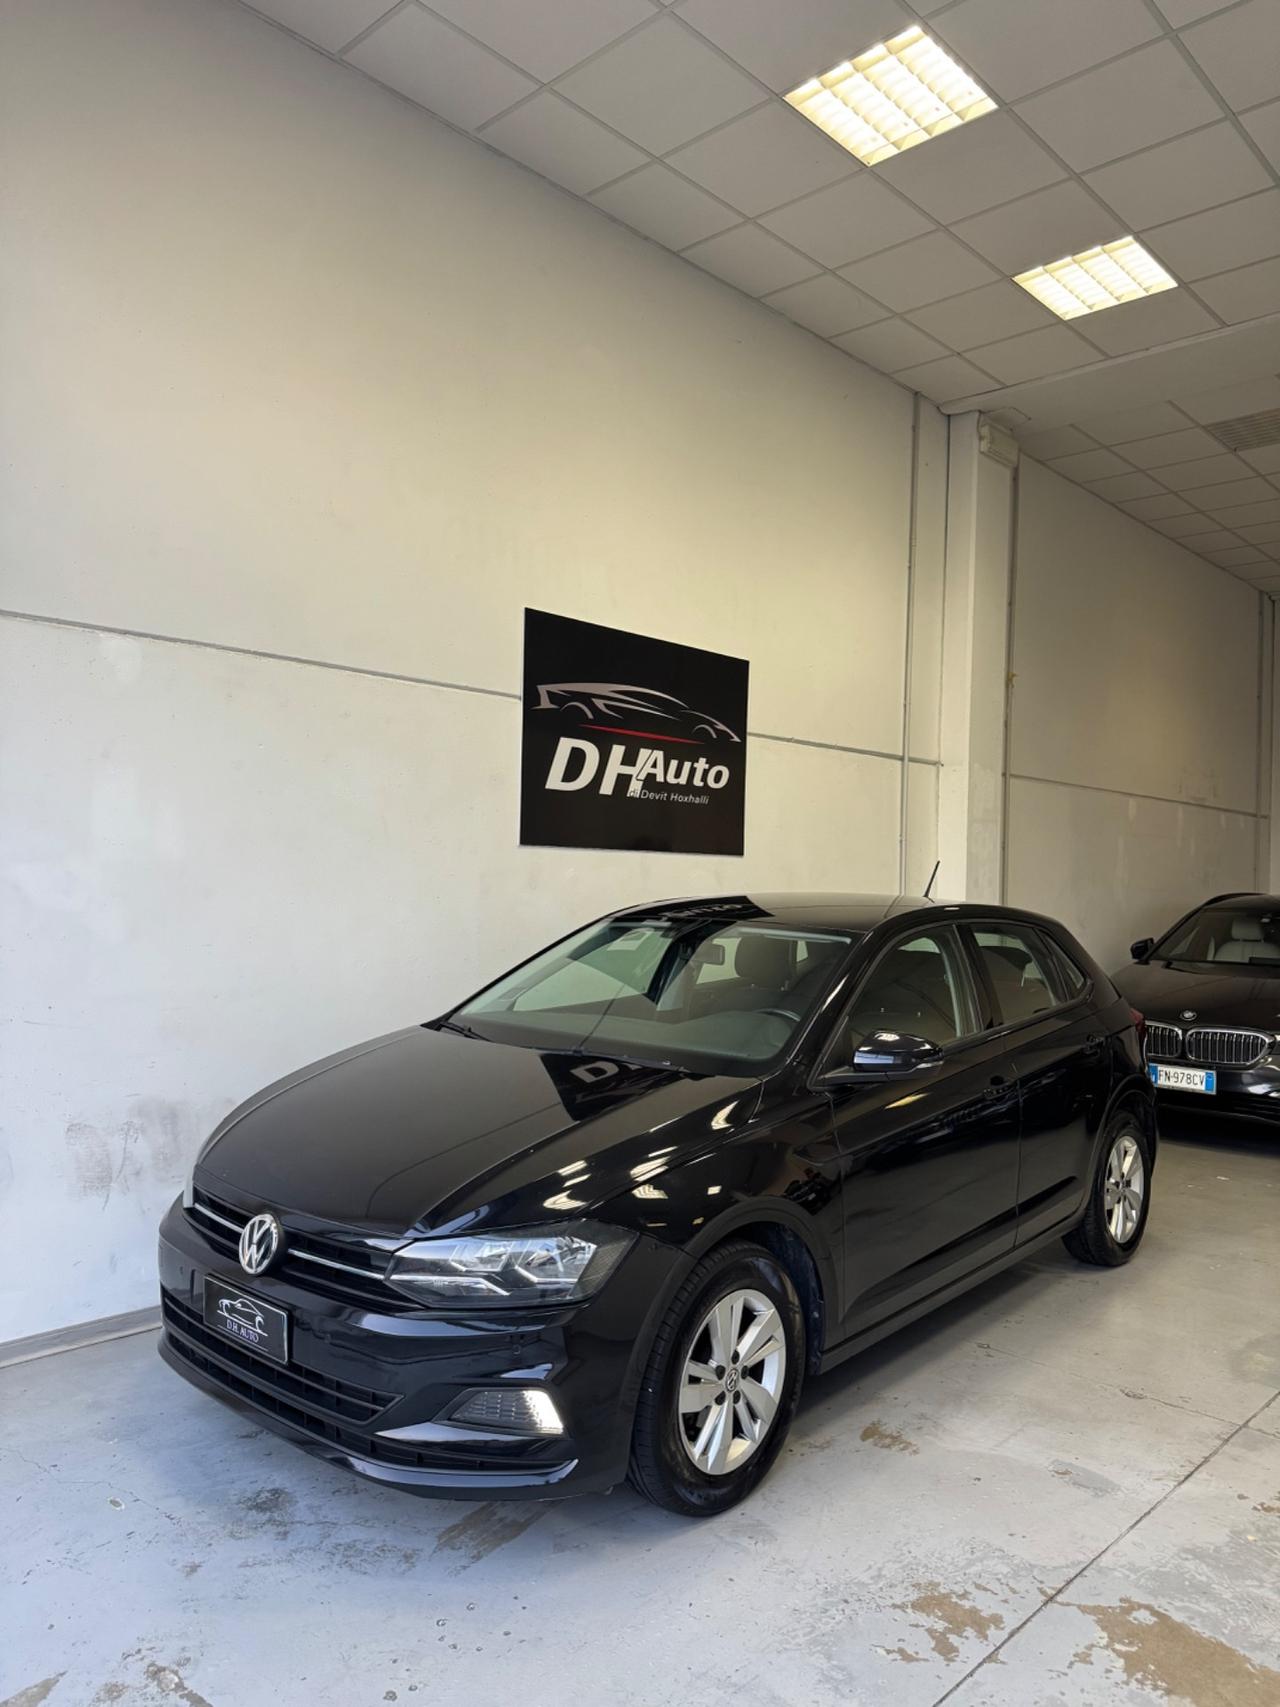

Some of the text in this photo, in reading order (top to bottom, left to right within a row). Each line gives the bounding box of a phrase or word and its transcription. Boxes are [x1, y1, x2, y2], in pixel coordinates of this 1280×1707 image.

[636, 749, 730, 789] Auto
[641, 790, 668, 801] Devit
[670, 792, 710, 804] Hoxhalli
[240, 1326, 259, 1343] AUTO
